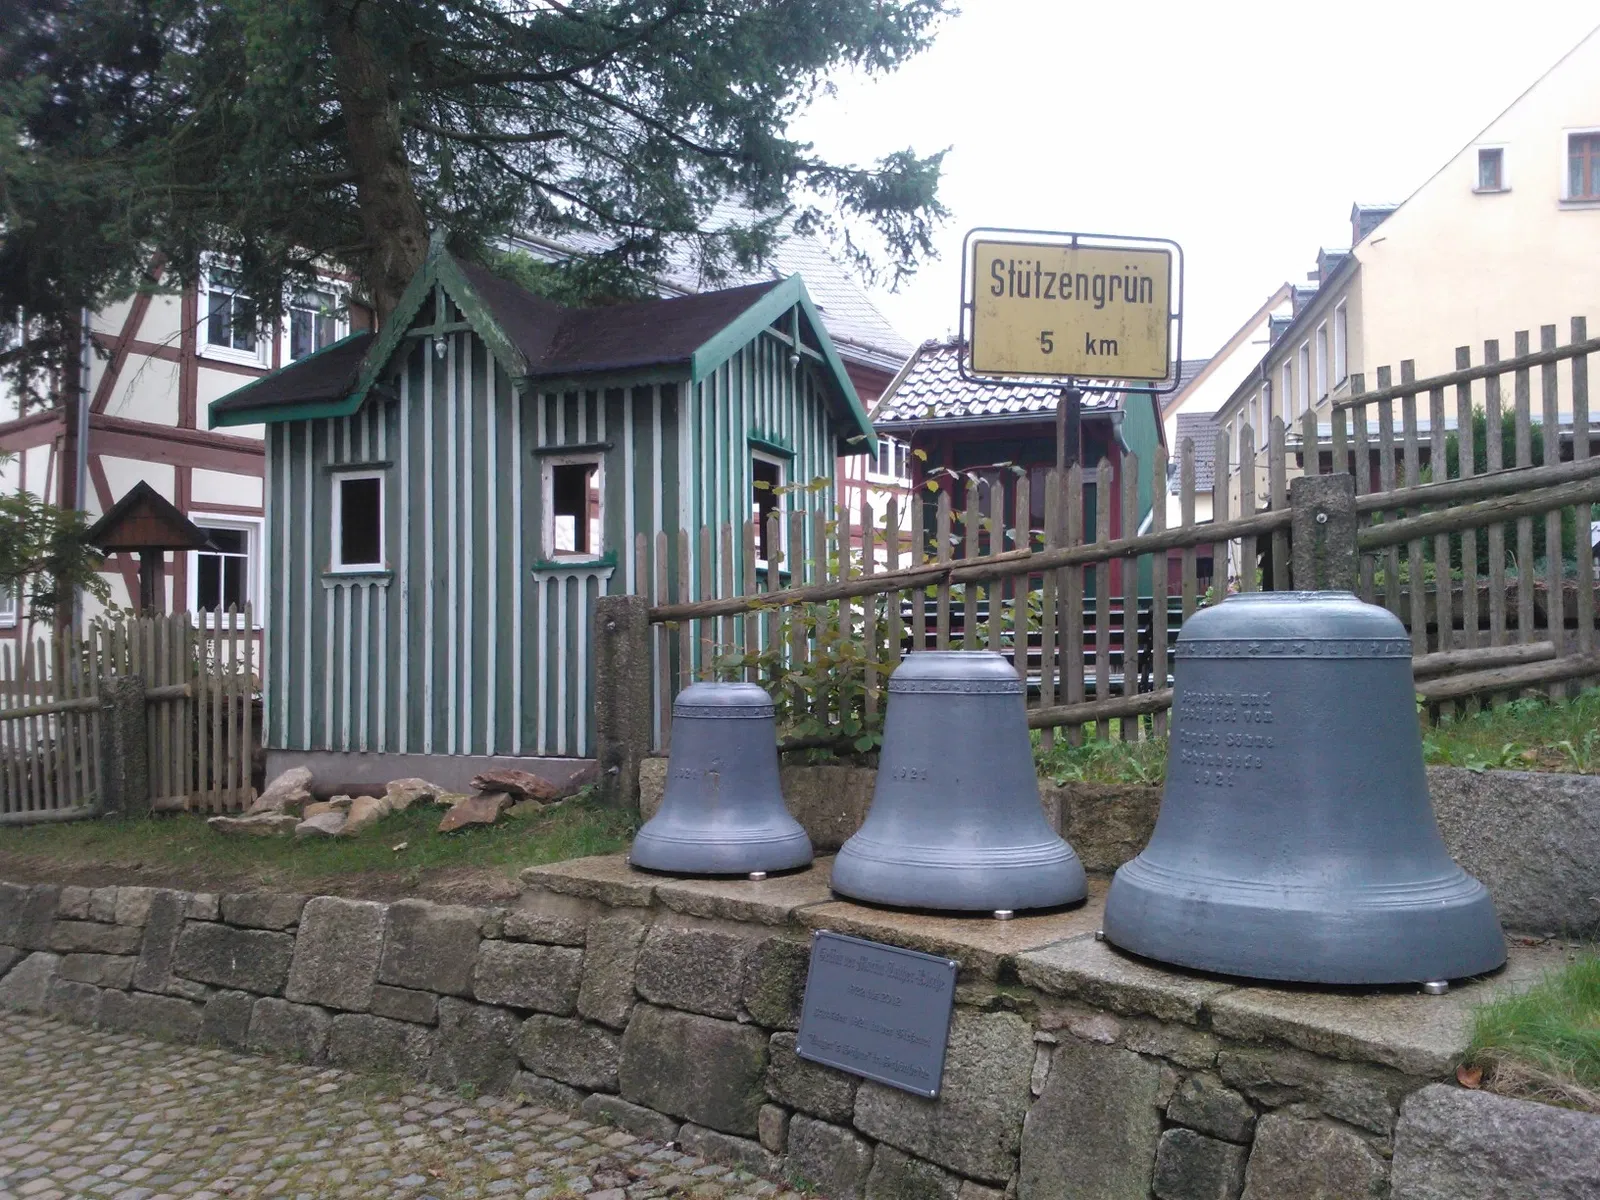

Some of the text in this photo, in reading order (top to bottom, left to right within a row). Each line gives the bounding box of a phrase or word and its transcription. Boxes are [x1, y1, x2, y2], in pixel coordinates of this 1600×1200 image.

[990, 258, 1153, 310] Stützengrün
[1040, 331, 1119, 356] 5 km
